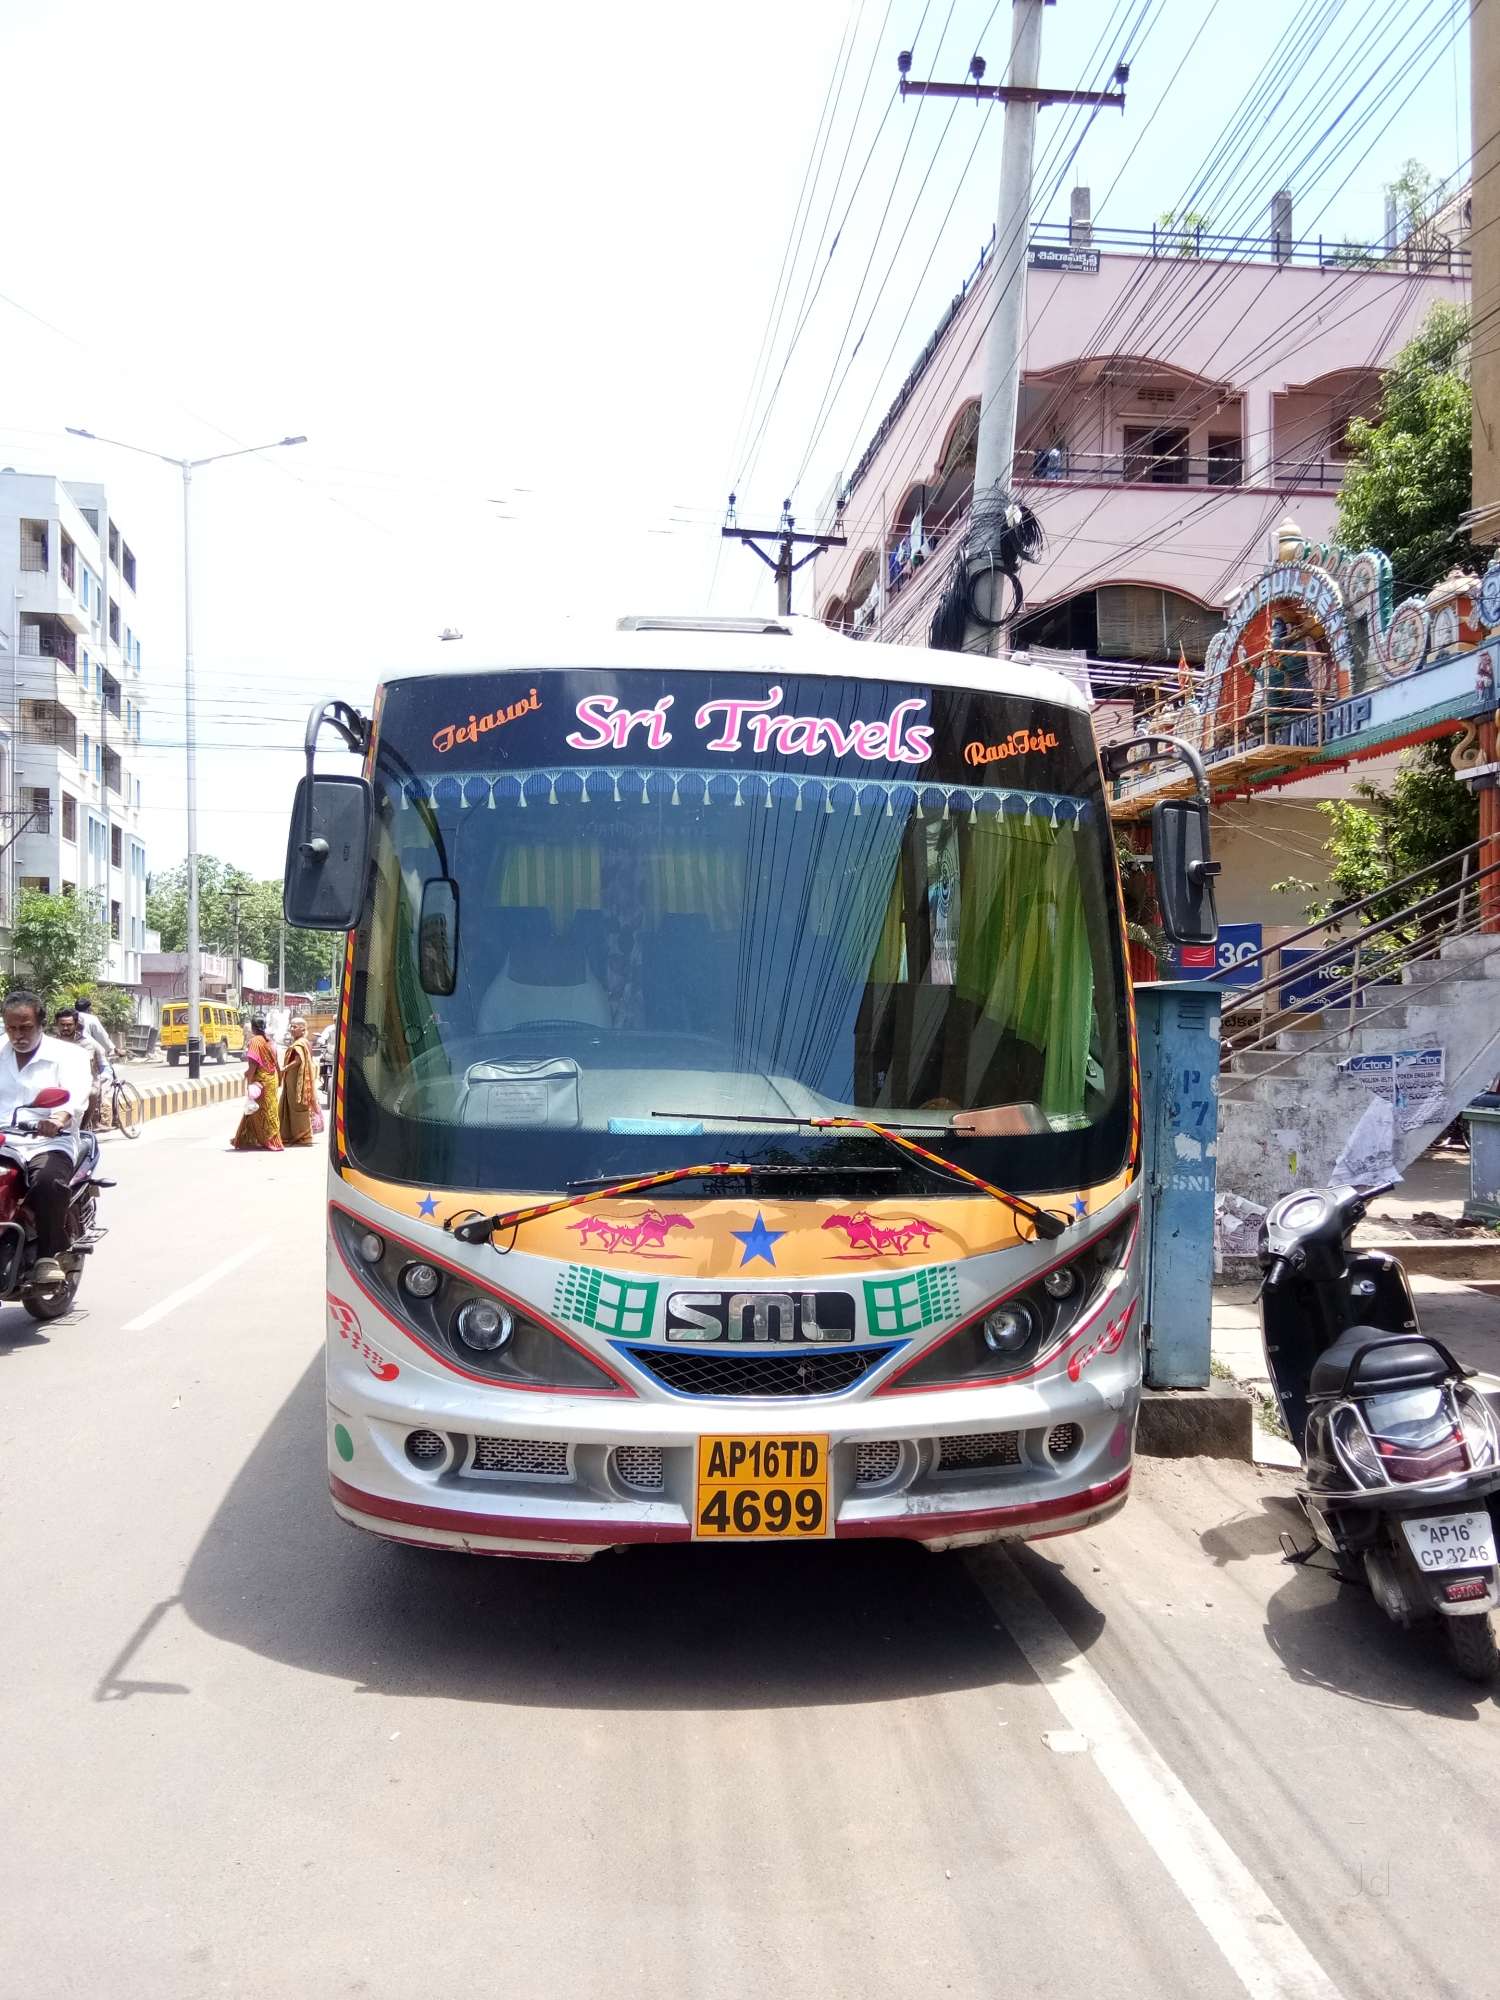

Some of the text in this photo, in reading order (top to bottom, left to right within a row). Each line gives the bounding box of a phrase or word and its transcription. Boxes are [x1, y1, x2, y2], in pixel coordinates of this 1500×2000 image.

[432, 688, 542, 753] Tejaswi
[695, 685, 934, 765] Travels
[1218, 941, 1258, 968] 3G
[1353, 1057, 1392, 1070] Victory
[667, 1293, 852, 1341] SML
[706, 1441, 819, 1478] AP16TD
[700, 1488, 824, 1533] 4699
[1430, 1524, 1470, 1544] AP16
[1420, 1545, 1489, 1567] CP 3246
